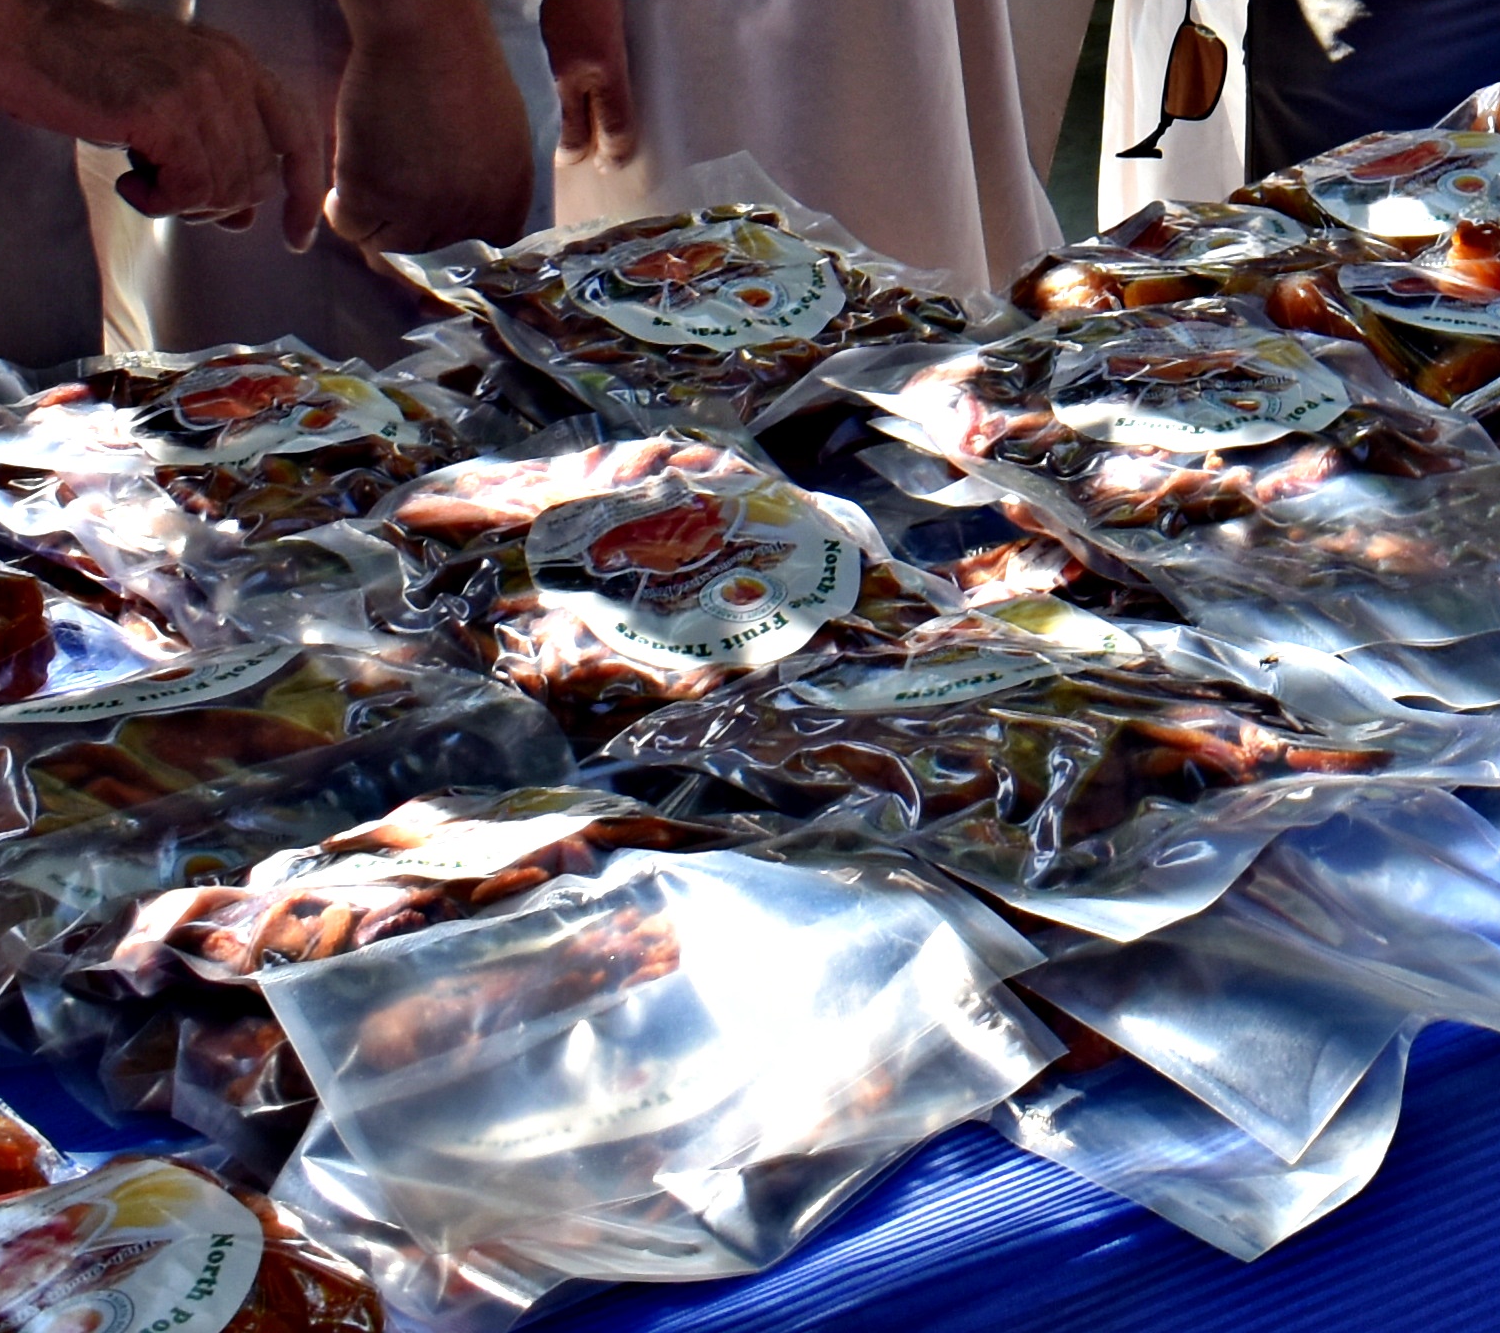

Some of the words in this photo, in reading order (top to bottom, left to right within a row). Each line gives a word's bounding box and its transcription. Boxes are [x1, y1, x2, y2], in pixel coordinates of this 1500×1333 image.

[818, 539, 842, 596] North
[720, 611, 790, 652] Fruit
[185, 1232, 235, 1301] North
